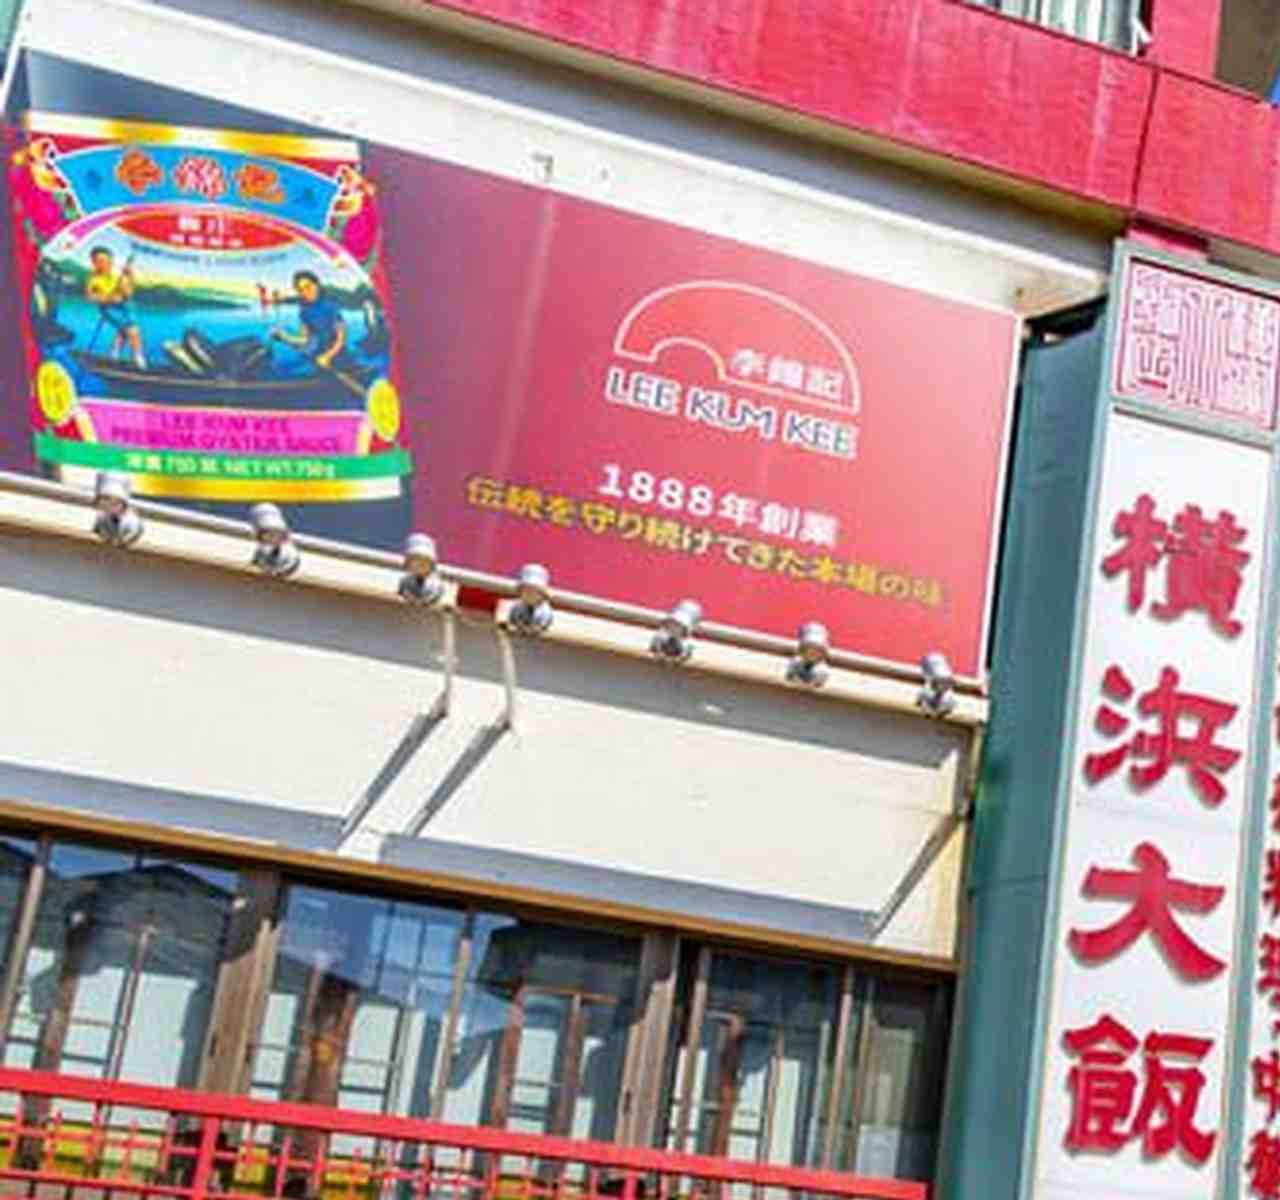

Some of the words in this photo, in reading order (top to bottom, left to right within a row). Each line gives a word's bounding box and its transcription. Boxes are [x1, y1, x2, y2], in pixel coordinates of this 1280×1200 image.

[606, 368, 681, 415] LEE
[686, 388, 778, 439] KUM
[782, 411, 859, 460] KEE
[466, 474, 943, 606] 伝統を守り続けてきた本場の味
[598, 464, 838, 548] 1888年創業
